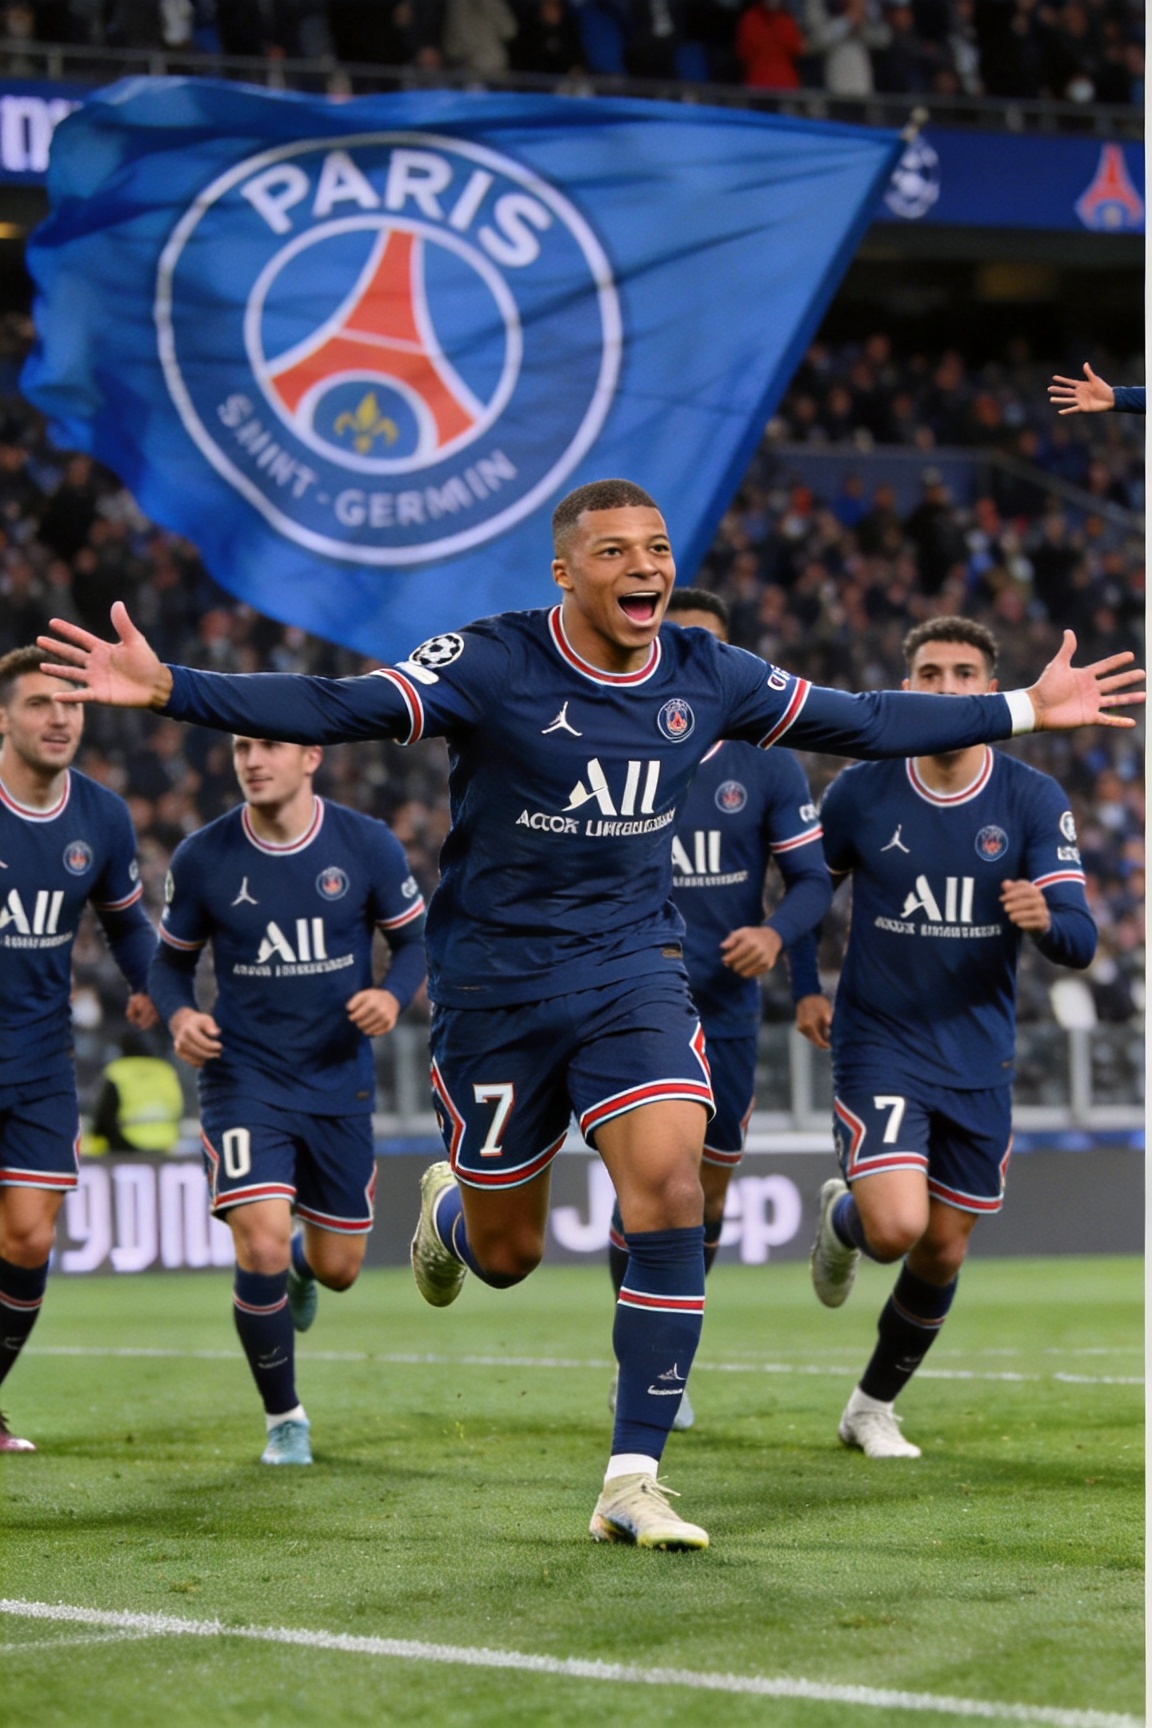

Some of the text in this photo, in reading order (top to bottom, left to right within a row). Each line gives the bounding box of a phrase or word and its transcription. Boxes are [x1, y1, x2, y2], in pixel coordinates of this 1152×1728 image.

[240, 150, 551, 268] PARIS
[473, 1082, 516, 1158] 7
[873, 1095, 906, 1144] 7
